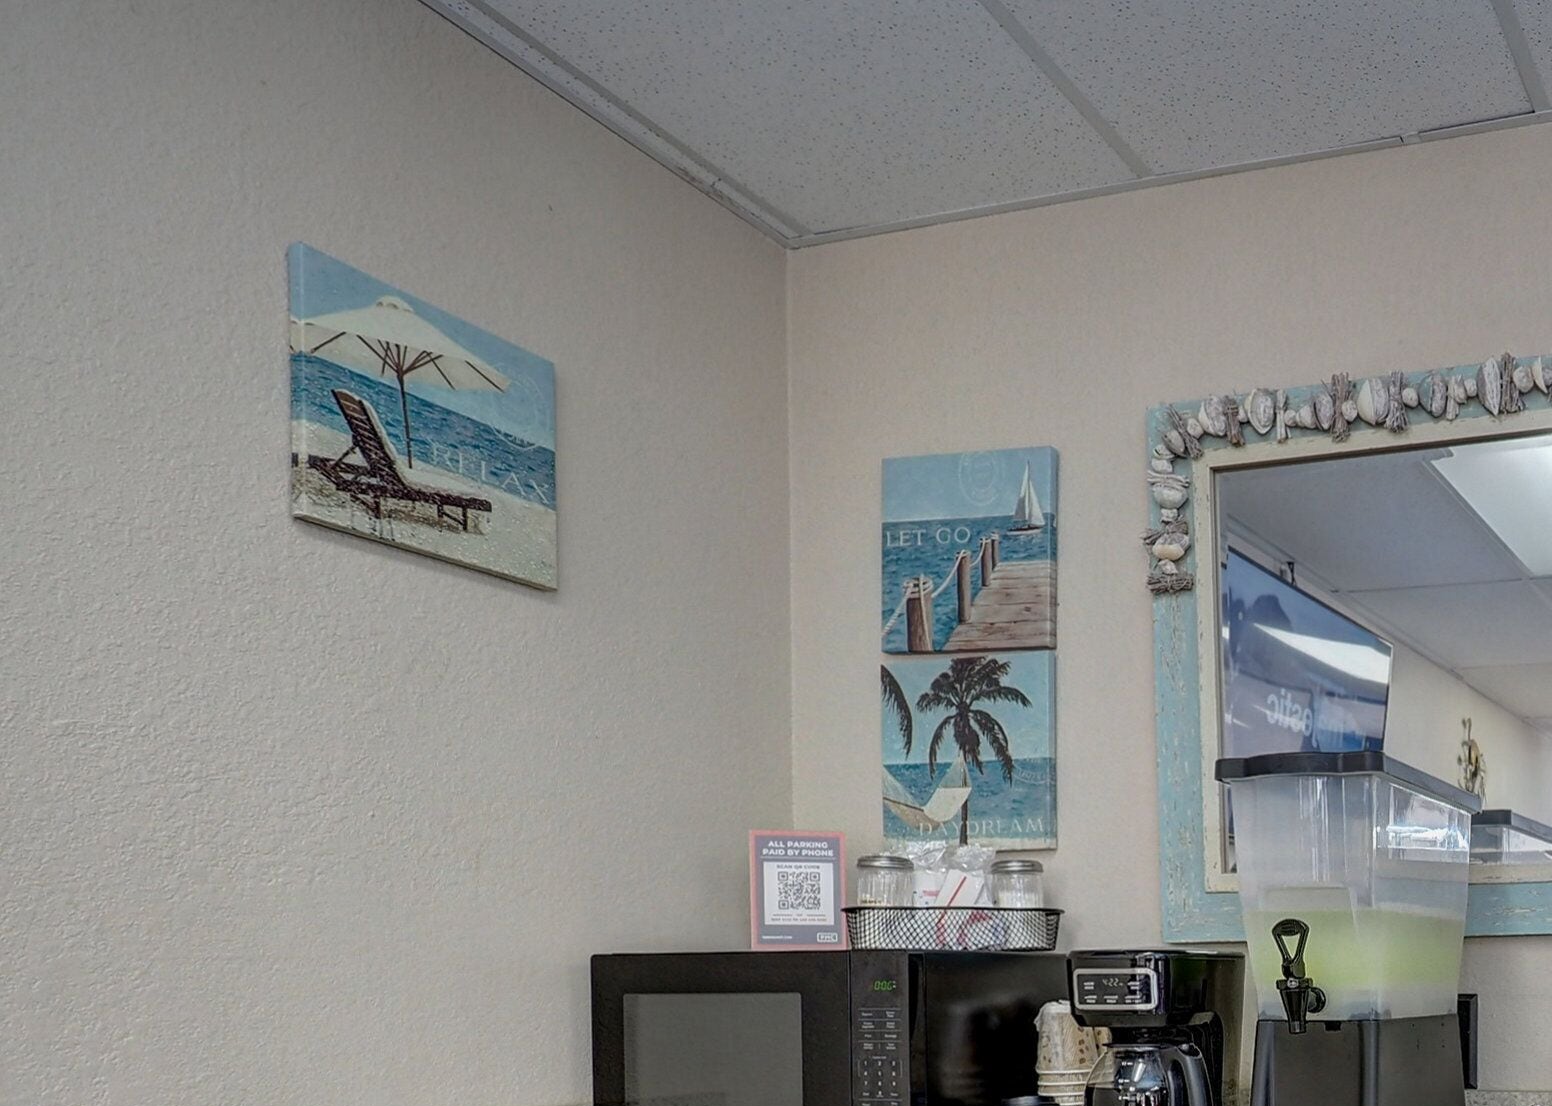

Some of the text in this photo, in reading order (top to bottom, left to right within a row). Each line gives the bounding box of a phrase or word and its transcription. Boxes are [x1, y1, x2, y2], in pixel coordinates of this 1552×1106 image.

[886, 526, 971, 547] LET GO
[919, 818, 1043, 836] DAYDREAM
[787, 841, 829, 849] PARKING
[762, 848, 786, 856] PAID
[801, 849, 834, 857] PHONE
